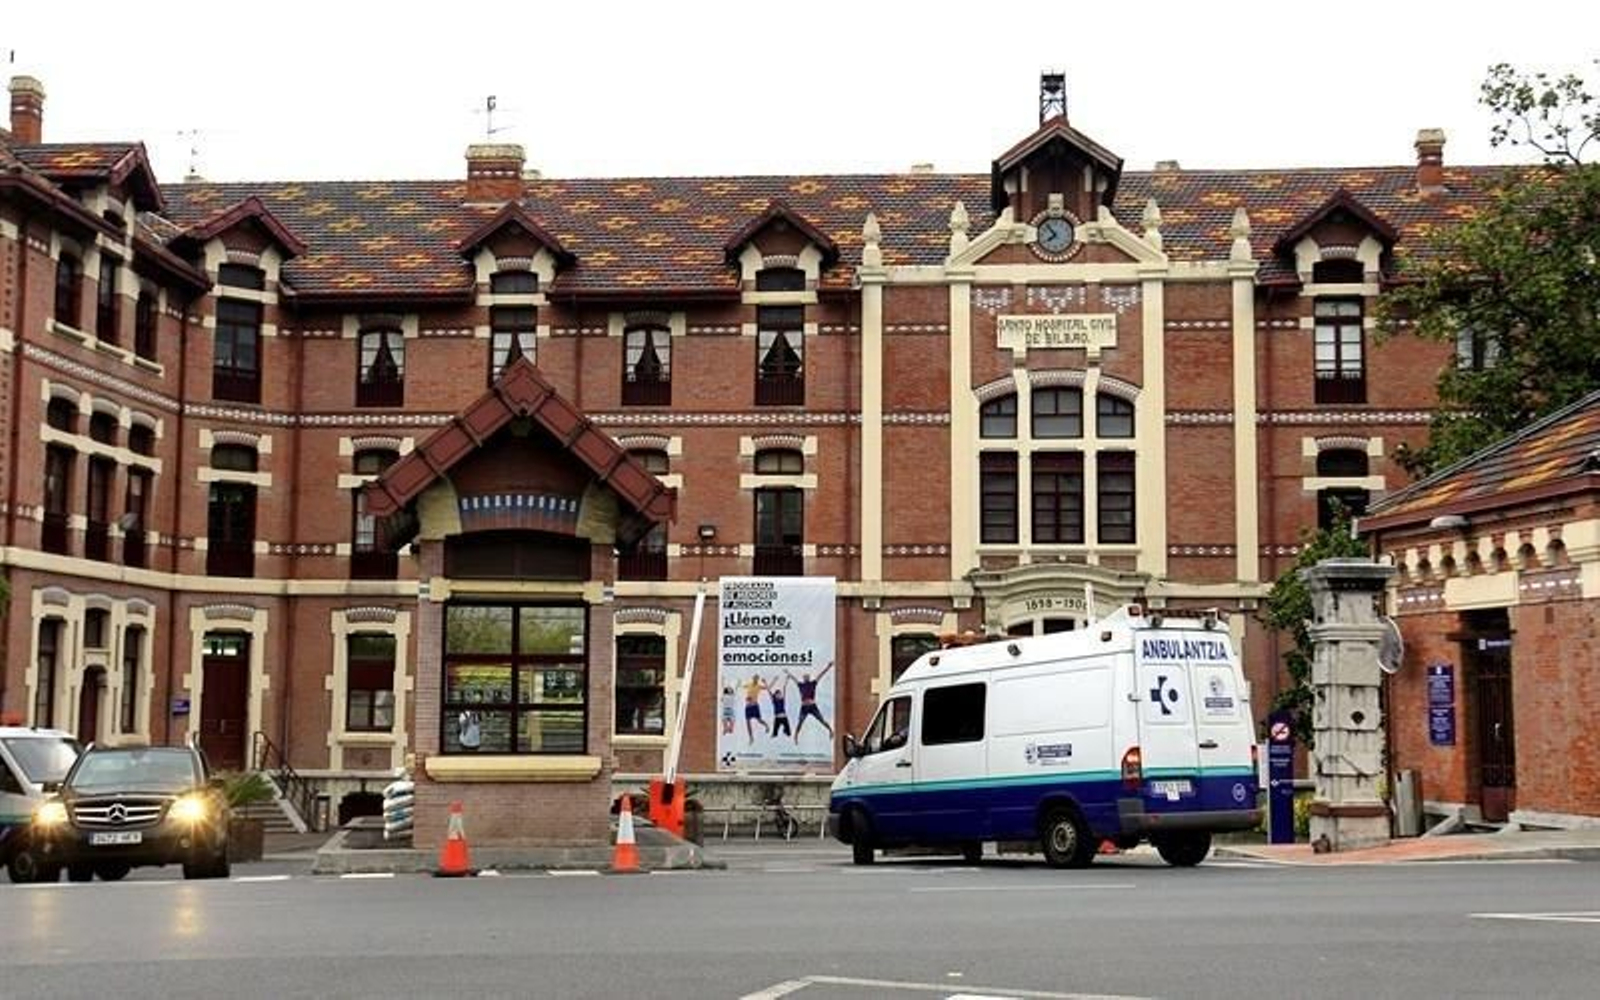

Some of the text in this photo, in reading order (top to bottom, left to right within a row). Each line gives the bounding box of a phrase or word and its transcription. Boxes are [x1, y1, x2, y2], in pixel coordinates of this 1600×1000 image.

[1035, 319, 1087, 332] HOSPITAL
[1025, 333, 1040, 344] DE
[723, 611, 792, 629] ¡Llénate,
[723, 631, 785, 647] pero de
[723, 649, 813, 663] emociones!
[1142, 639, 1229, 660] ANBULANTZIA
